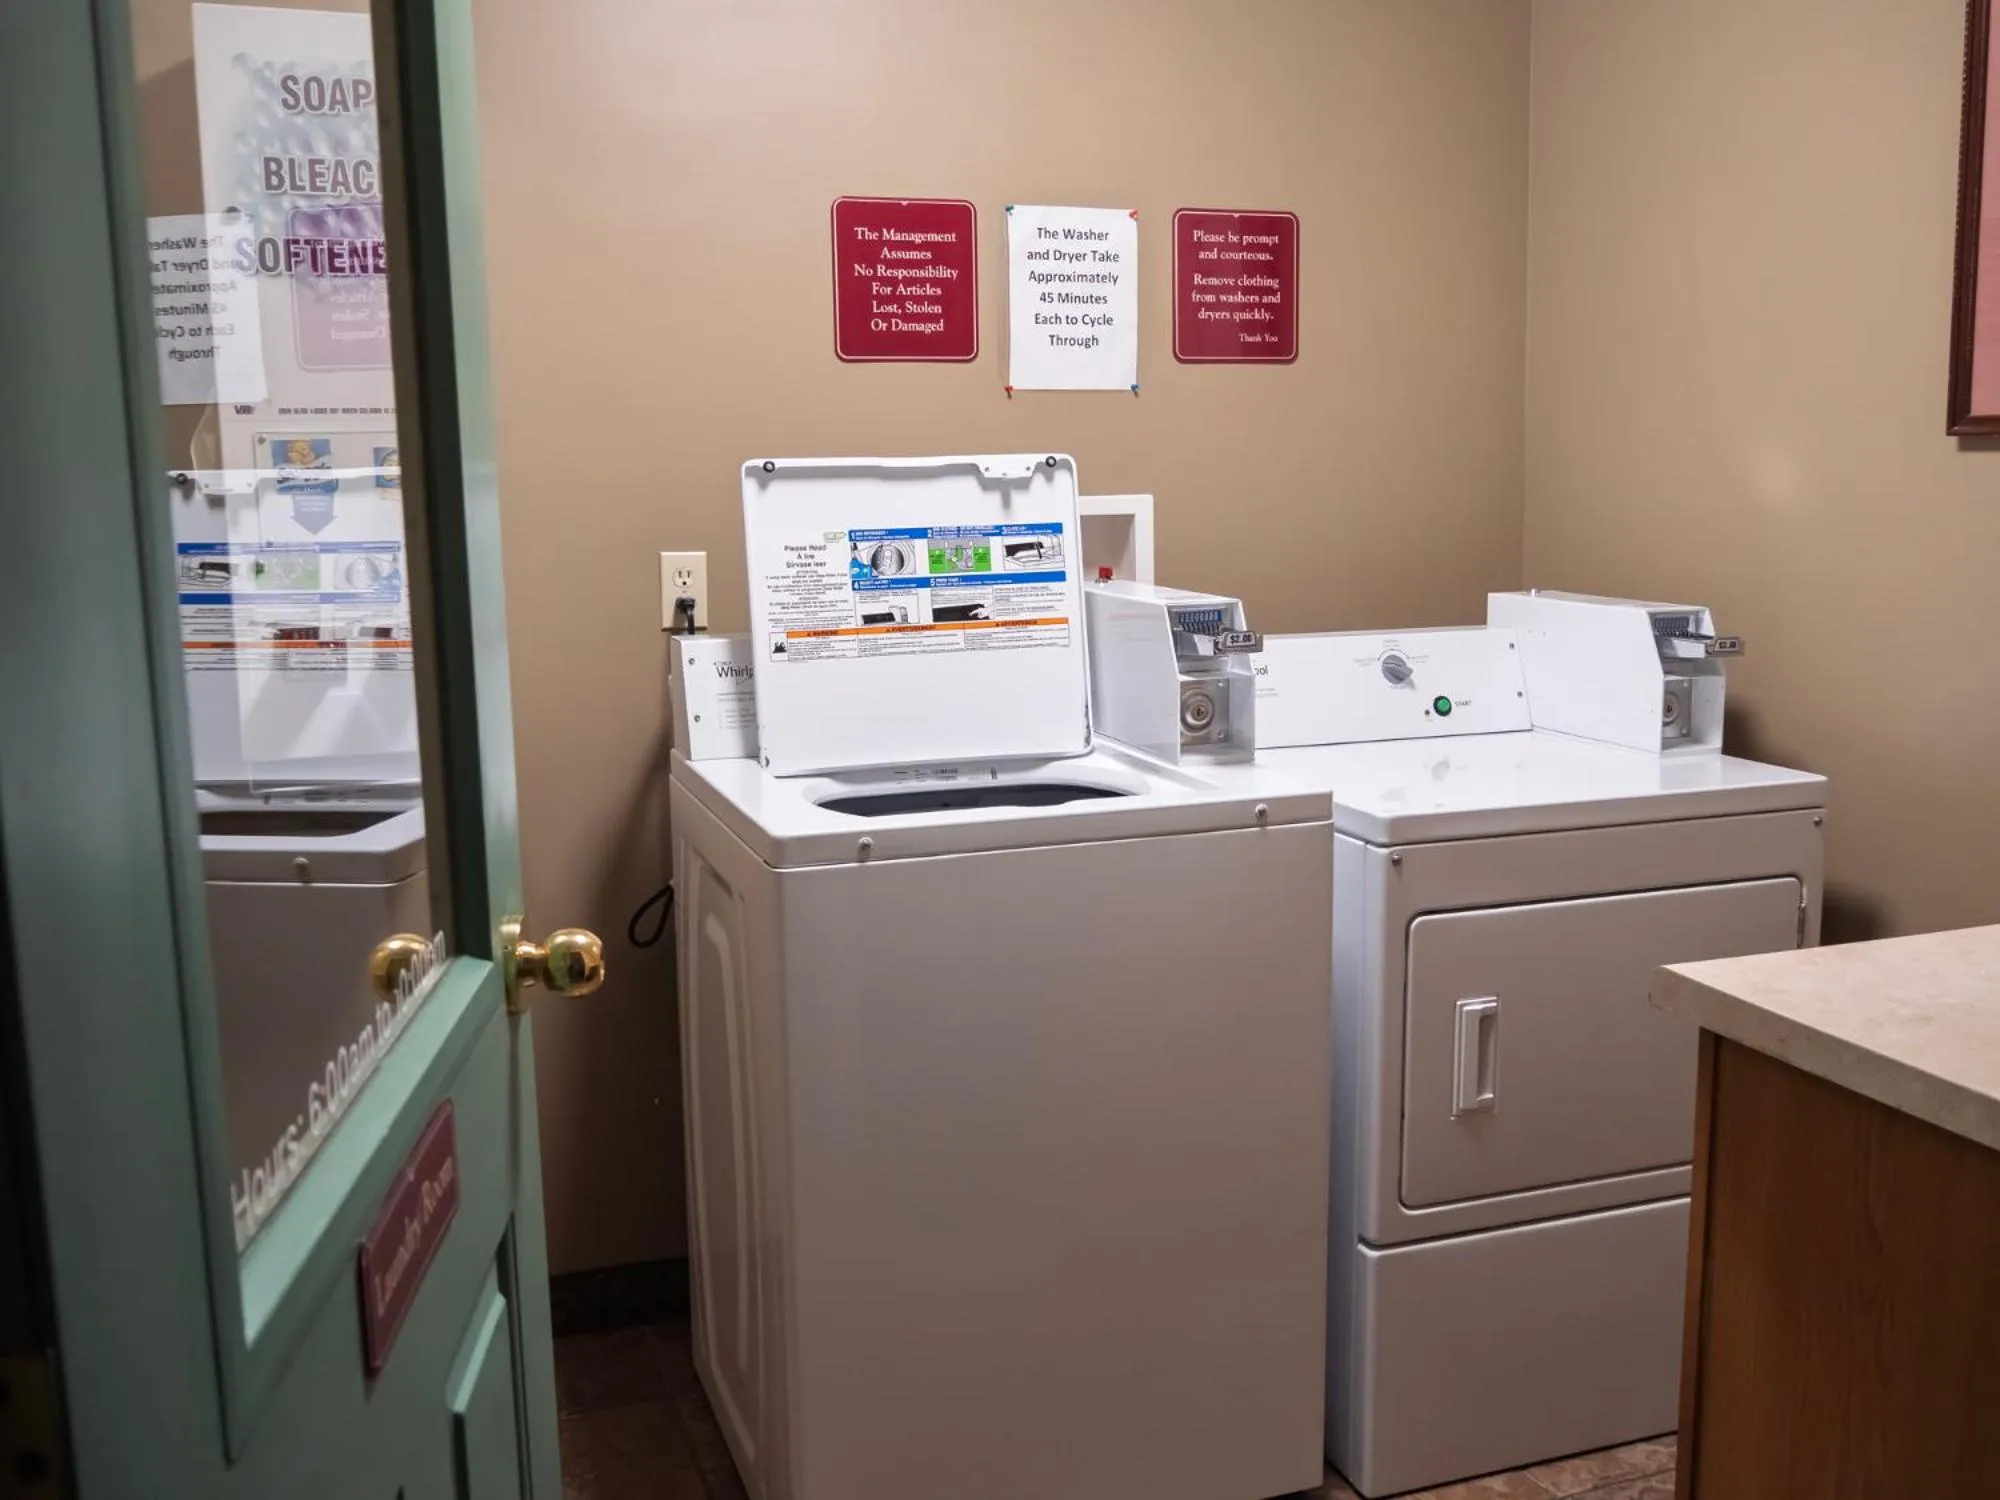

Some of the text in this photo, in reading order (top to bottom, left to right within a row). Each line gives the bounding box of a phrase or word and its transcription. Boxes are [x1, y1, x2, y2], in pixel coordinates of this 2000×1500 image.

[280, 74, 374, 113] SOAP
[263, 156, 380, 195] BLEAC
[854, 227, 957, 244] The Management
[1037, 227, 1110, 241] The Washer
[1192, 229, 1280, 247] Please be prompt
[880, 246, 932, 260] Assumes
[1027, 249, 1120, 264] and Dryer Take
[1198, 247, 1274, 261] and courteous.
[853, 263, 958, 280] No Responsibility
[1028, 270, 1120, 287] Approximately
[1193, 273, 1280, 289] Remove clothing
[871, 282, 942, 296] For Articles
[1191, 289, 1281, 304] from washers and
[1039, 292, 1108, 305] 45 Minutes
[872, 300, 942, 314] Lost, Stolen
[1198, 307, 1274, 322] dryers quickly.
[871, 318, 945, 334] Or Damaged
[1034, 312, 1114, 328] Each to Cycle
[1048, 334, 1099, 349] Through
[1239, 332, 1279, 343] Thank You
[230, 1113, 304, 1254] Hours:
[308, 1024, 374, 1137] 6:00am
[375, 1001, 392, 1045] to
